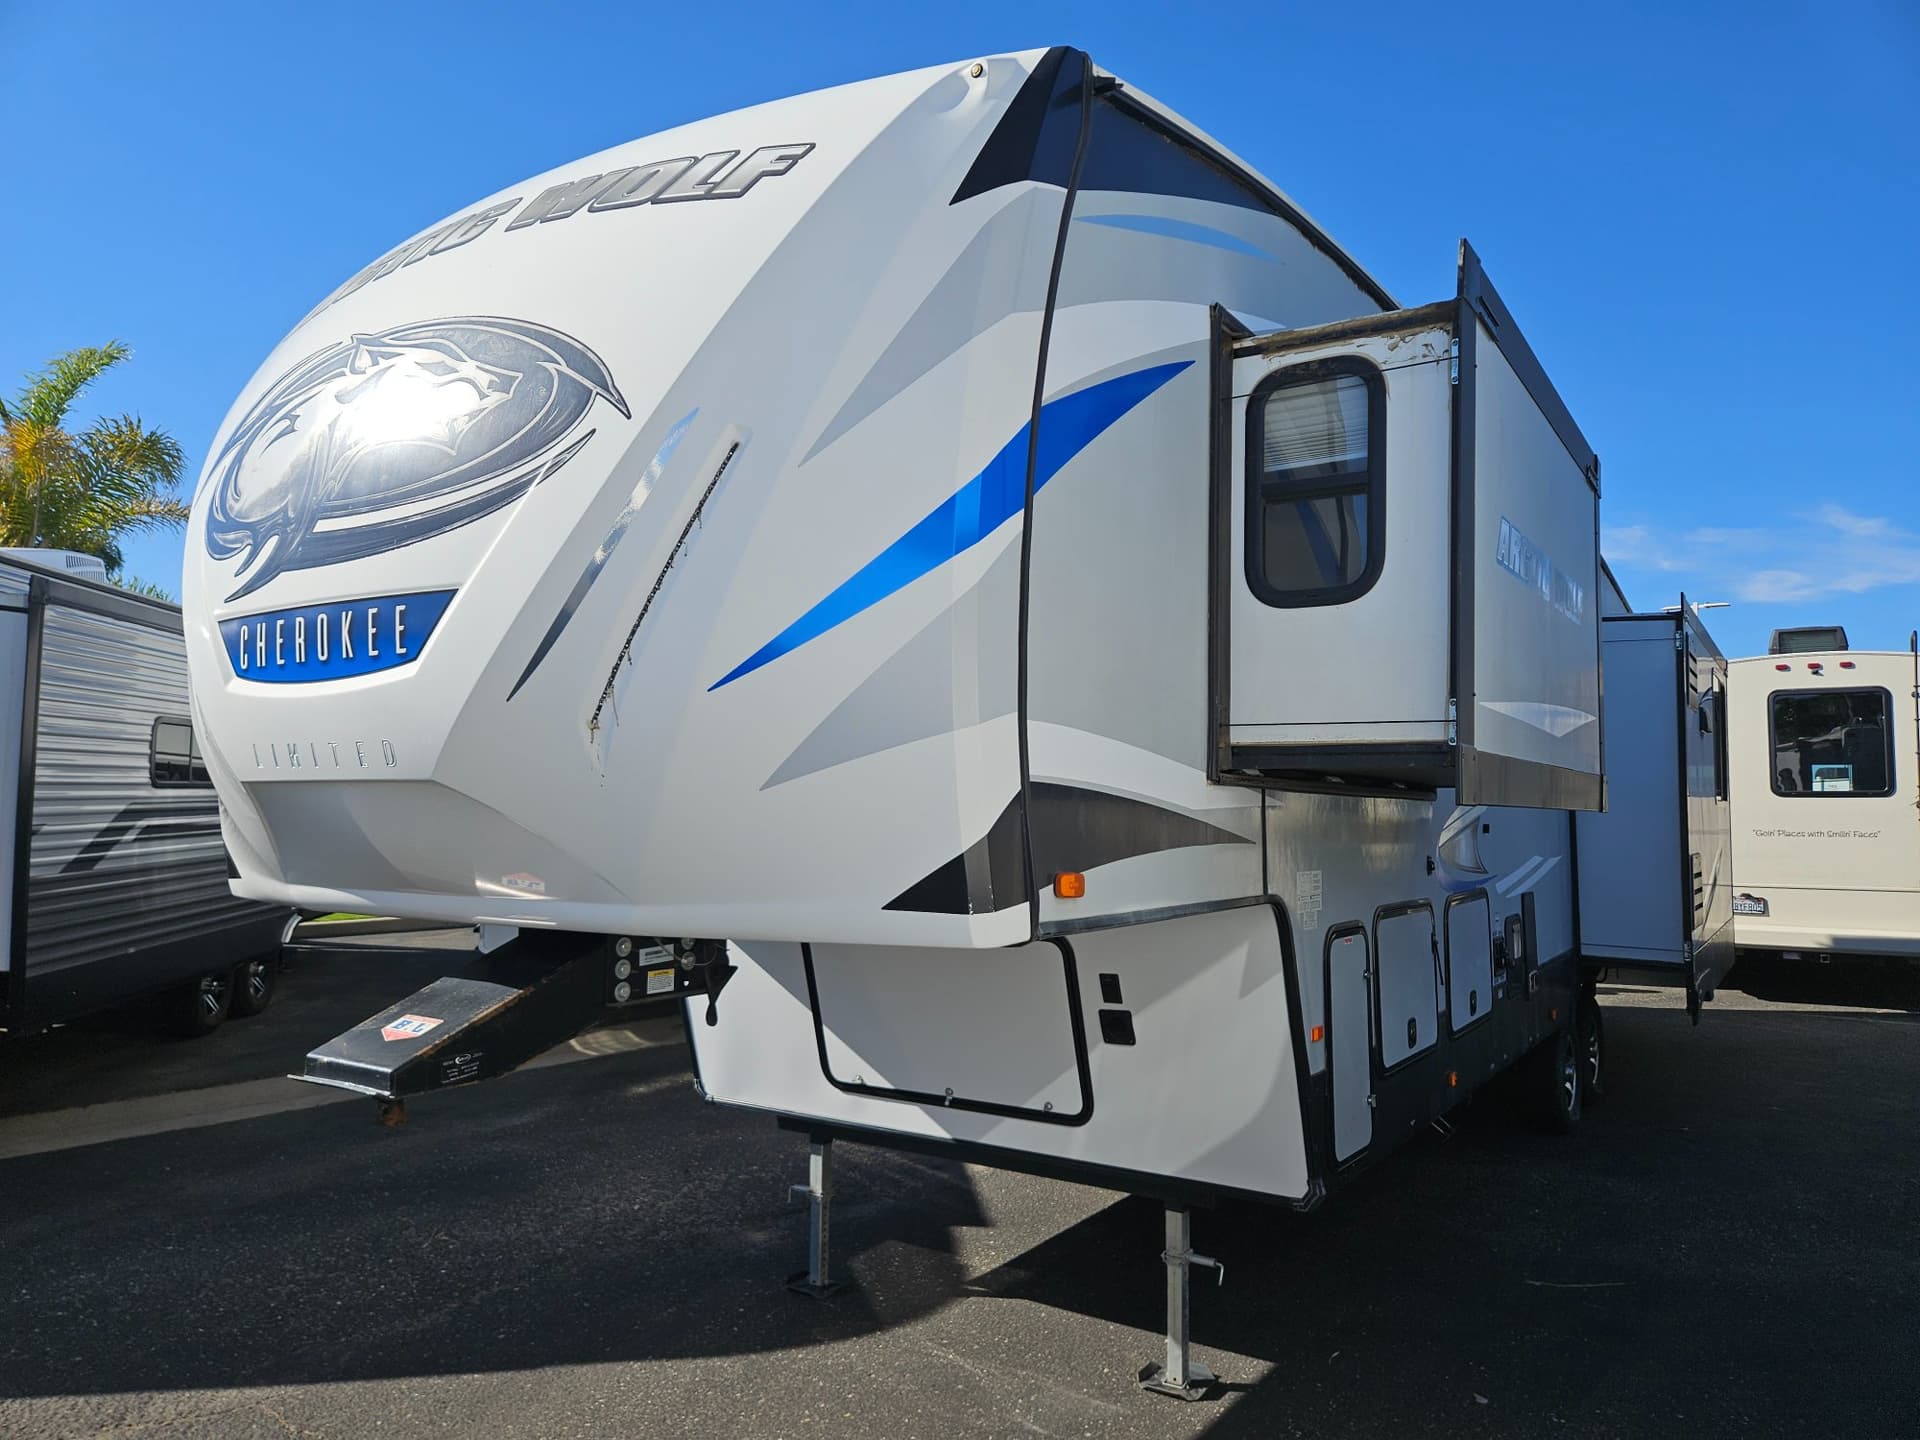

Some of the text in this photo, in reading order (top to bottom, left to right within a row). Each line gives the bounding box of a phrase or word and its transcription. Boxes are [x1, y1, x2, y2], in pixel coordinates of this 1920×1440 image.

[504, 142, 817, 233] WOLF
[239, 604, 407, 670] CHEROKEE
[252, 738, 398, 769] LIMITED
[1777, 829, 1805, 837] Places
[1807, 830, 1825, 838] with
